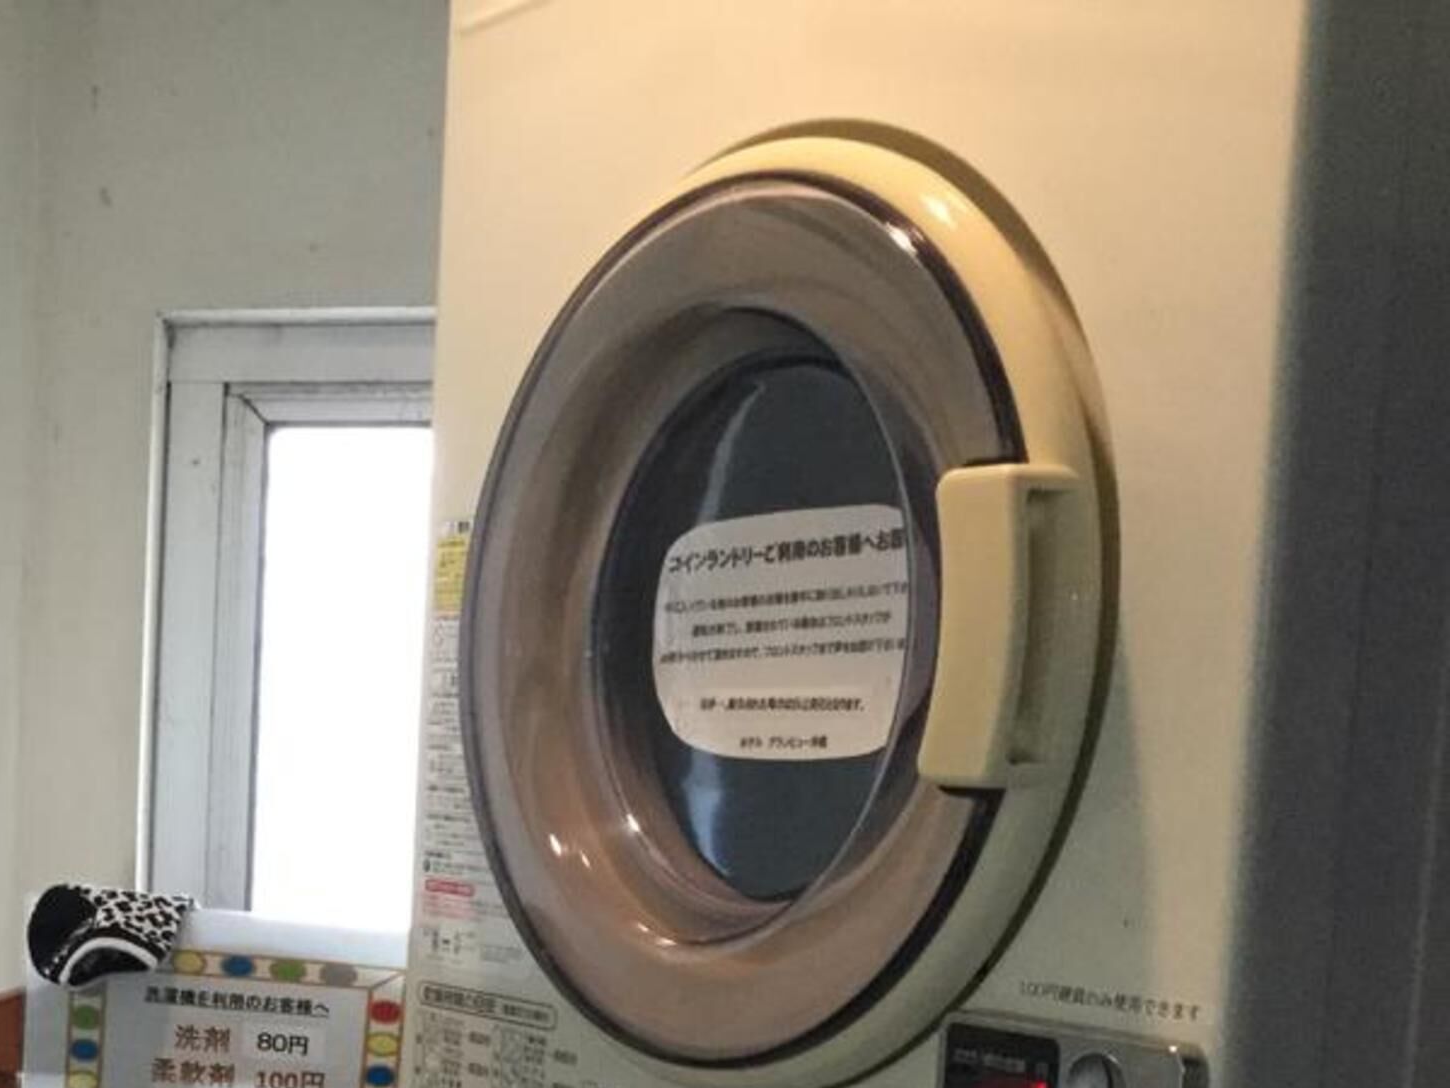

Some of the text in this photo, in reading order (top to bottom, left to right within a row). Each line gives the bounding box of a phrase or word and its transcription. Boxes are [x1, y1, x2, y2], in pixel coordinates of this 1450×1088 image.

[174, 1025, 309, 1056] 洗剤 80円
[151, 1058, 236, 1088] 柔軟剤
